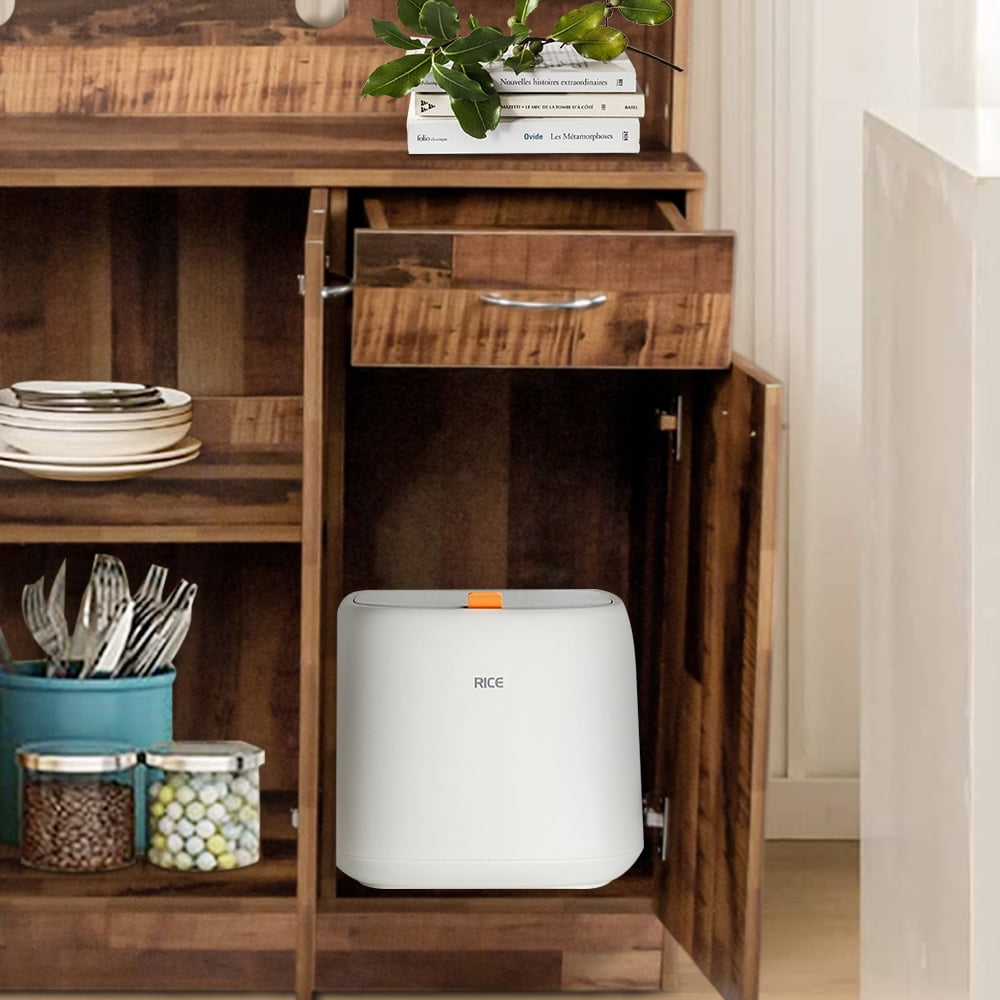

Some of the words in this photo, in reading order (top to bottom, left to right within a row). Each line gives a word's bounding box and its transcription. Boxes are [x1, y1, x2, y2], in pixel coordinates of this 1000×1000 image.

[500, 78, 531, 86] Nouvelles
[533, 78, 559, 86] histoires
[561, 78, 608, 86] extraordinaires
[524, 132, 543, 140] Ovide
[551, 132, 561, 140] Les
[563, 132, 613, 141] Métamorphoses
[474, 677, 504, 689] RICE
